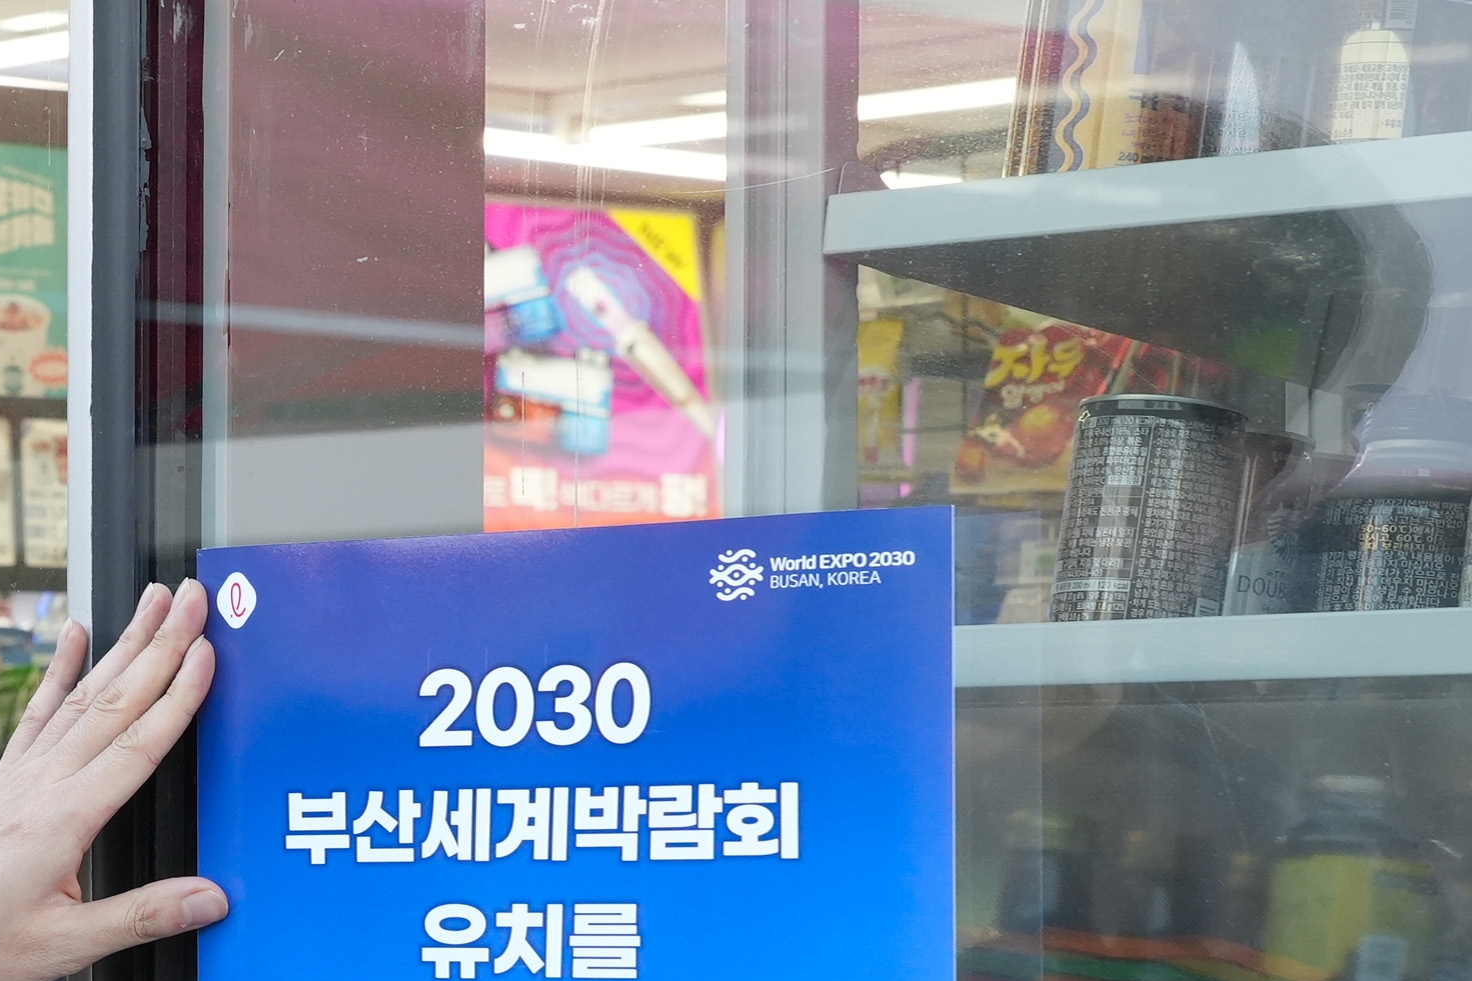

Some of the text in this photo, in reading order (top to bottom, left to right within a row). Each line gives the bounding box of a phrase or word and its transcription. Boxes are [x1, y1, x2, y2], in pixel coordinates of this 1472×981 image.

[770, 549, 916, 572] World EXPO 2030
[770, 571, 882, 590] BUSAN, KOREA
[418, 662, 652, 748] 2030
[284, 782, 800, 865] 부산세계박람회
[421, 902, 642, 980] 유치를
